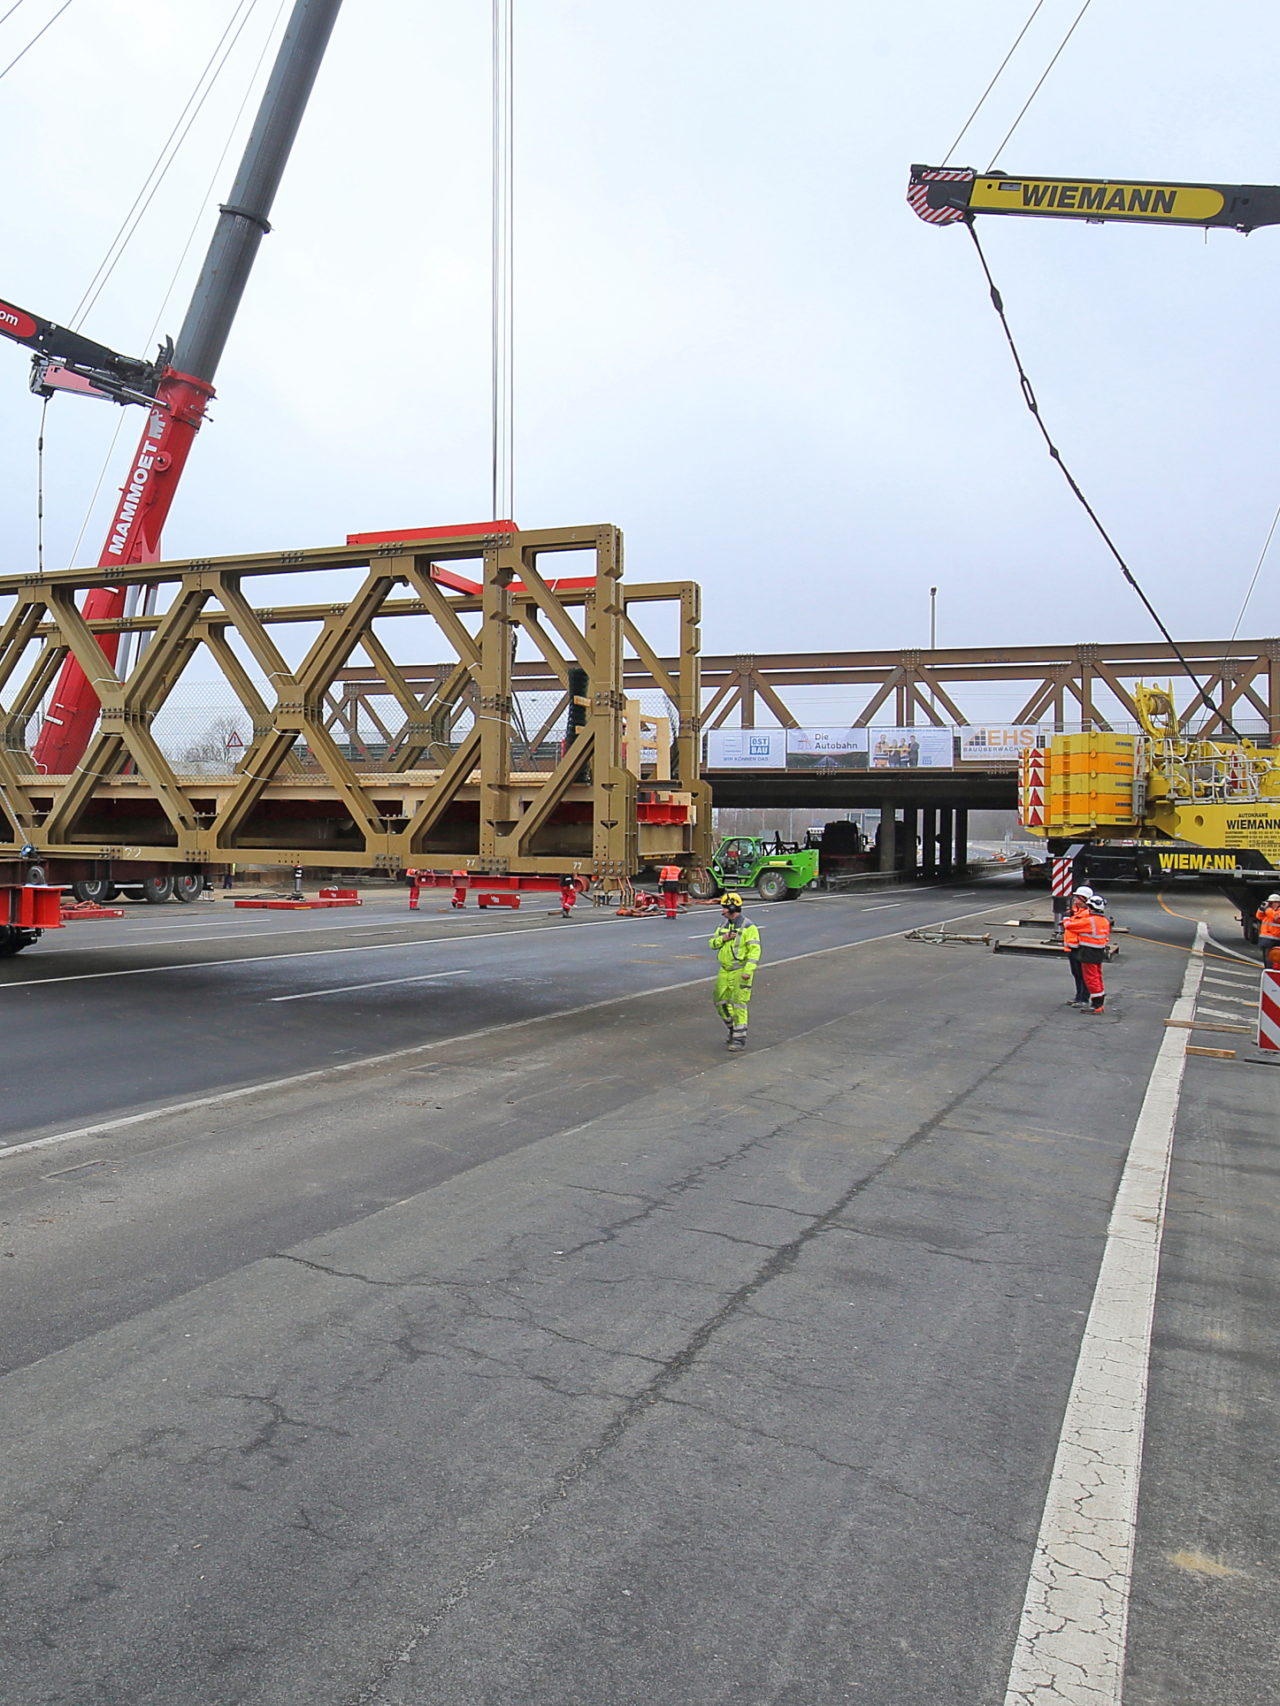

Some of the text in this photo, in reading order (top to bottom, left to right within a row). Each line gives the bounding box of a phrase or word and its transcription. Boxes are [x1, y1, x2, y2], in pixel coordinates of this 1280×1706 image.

[1022, 184, 1177, 214] WIEMANN
[108, 440, 158, 555] MAMMOET
[988, 729, 1035, 746] EHS
[1226, 819, 1280, 830] WIEMANN
[1158, 853, 1236, 869] WIEMANN
